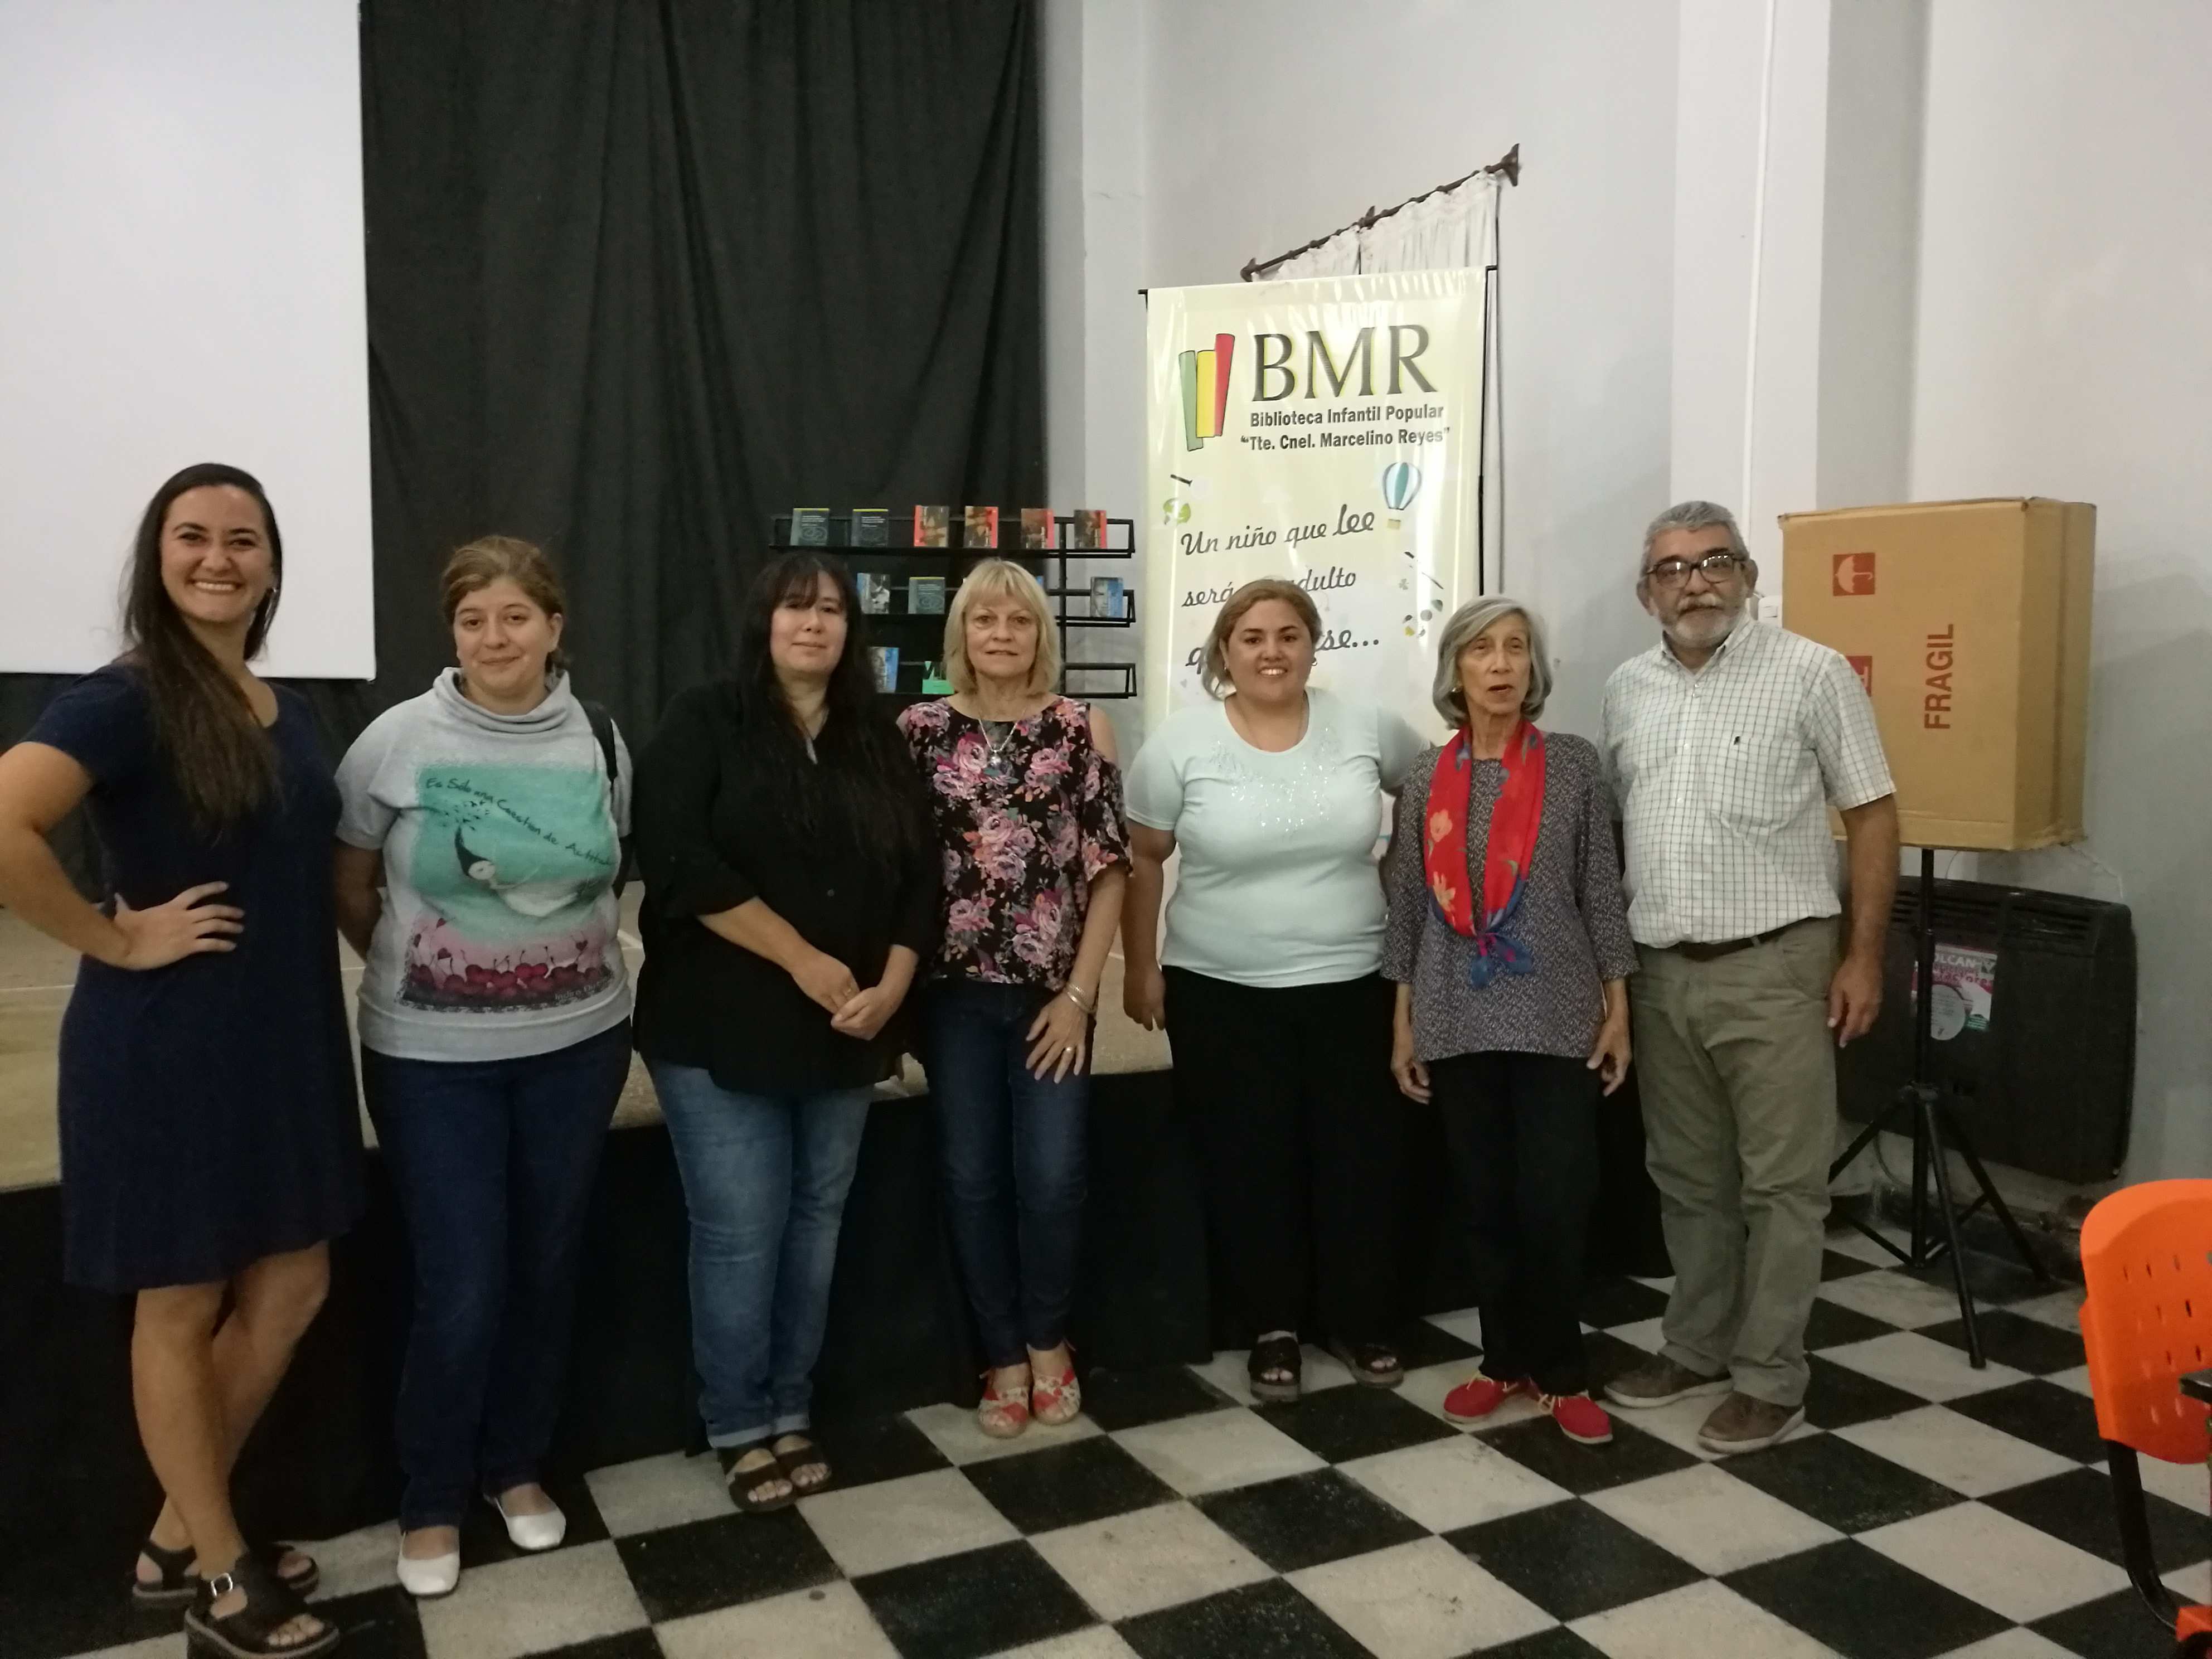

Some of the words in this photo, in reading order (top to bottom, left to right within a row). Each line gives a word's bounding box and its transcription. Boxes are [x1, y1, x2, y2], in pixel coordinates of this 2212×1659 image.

[1252, 324, 1438, 401] BMR
[1250, 411, 1323, 428] Biblioteca
[1327, 406, 1381, 424] Infantil
[1386, 404, 1445, 423] Popular
[1279, 433, 1315, 450] Cnel.
[1320, 430, 1393, 448] Marcelino
[1180, 531, 1219, 556] Un
[1225, 525, 1277, 550] niño
[1284, 523, 1327, 549] que
[1332, 503, 1375, 536] lee
[1181, 581, 1234, 607] será
[1292, 566, 1356, 592] dulto
[1924, 624, 1953, 729] FRAGIL
[474, 790, 494, 803] una
[543, 832, 559, 845] de
